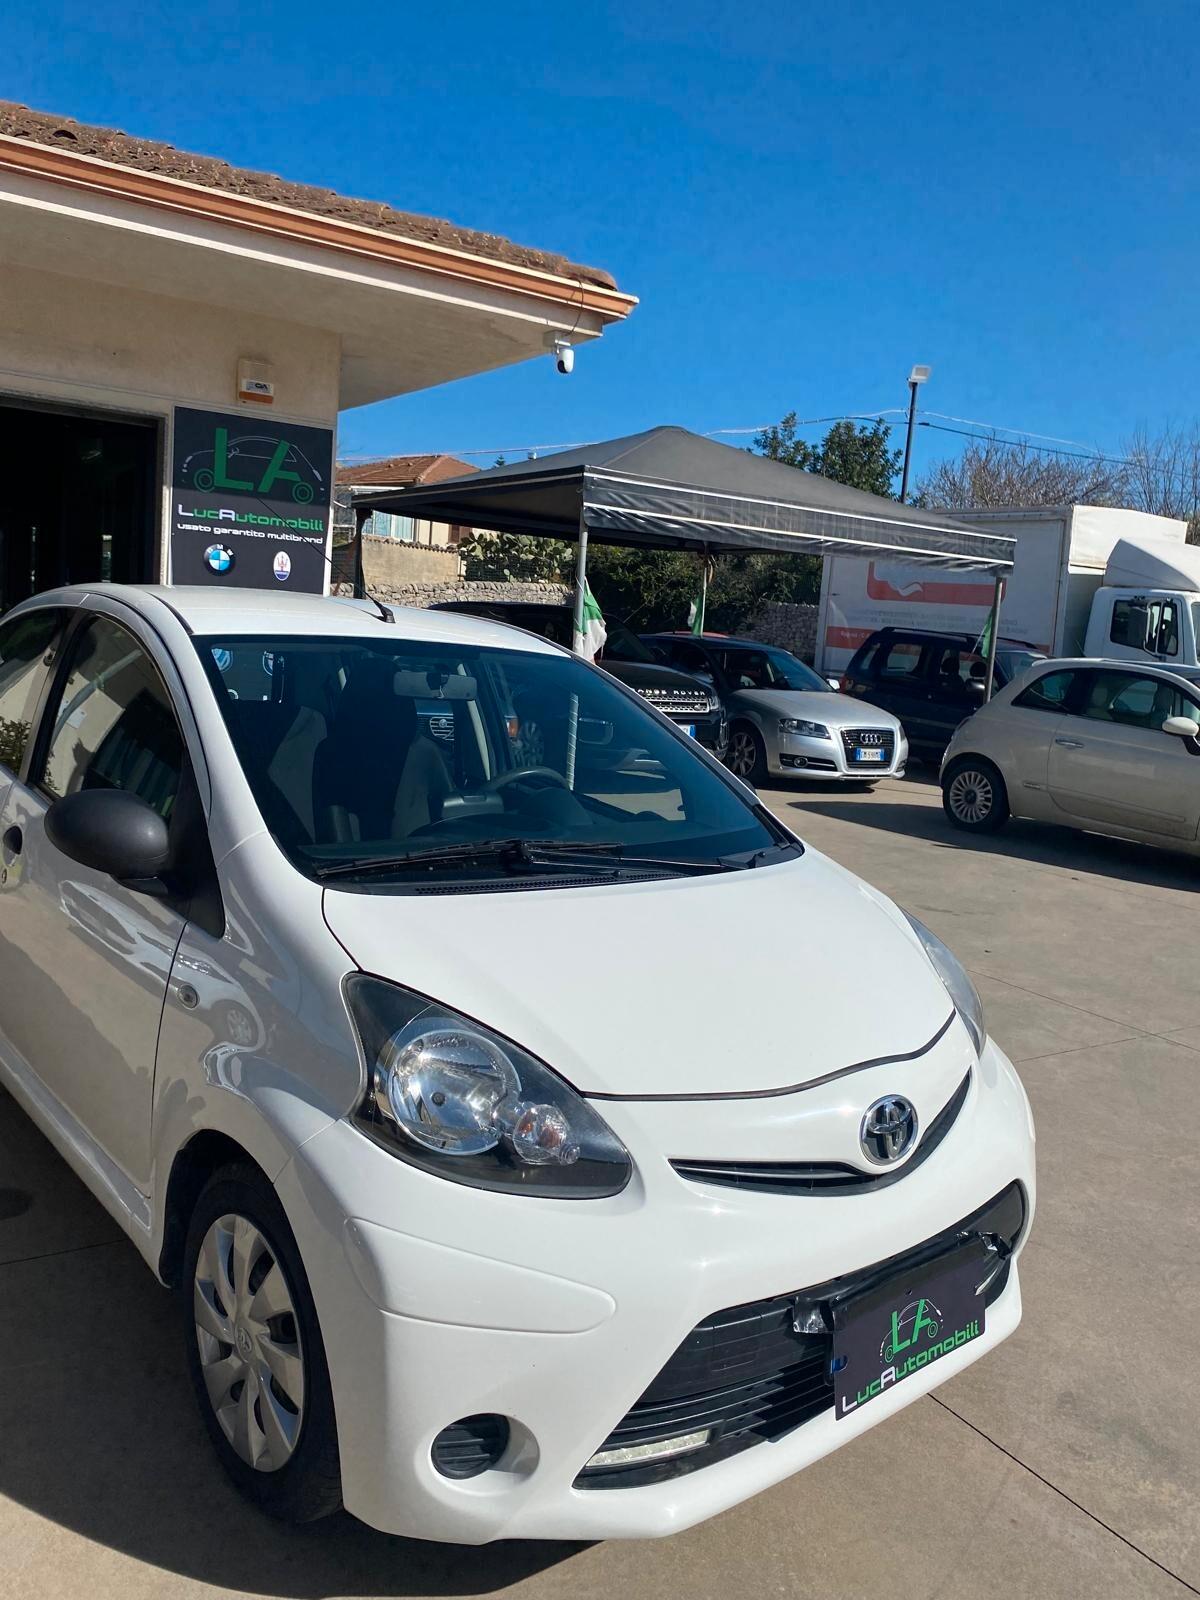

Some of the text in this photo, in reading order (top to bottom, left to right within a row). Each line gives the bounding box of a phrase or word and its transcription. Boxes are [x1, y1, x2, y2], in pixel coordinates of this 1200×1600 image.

[177, 504, 324, 532] LucAutomobili
[177, 524, 323, 544] usato garantito multibrand
[842, 1319, 979, 1413] LucAutomobili
